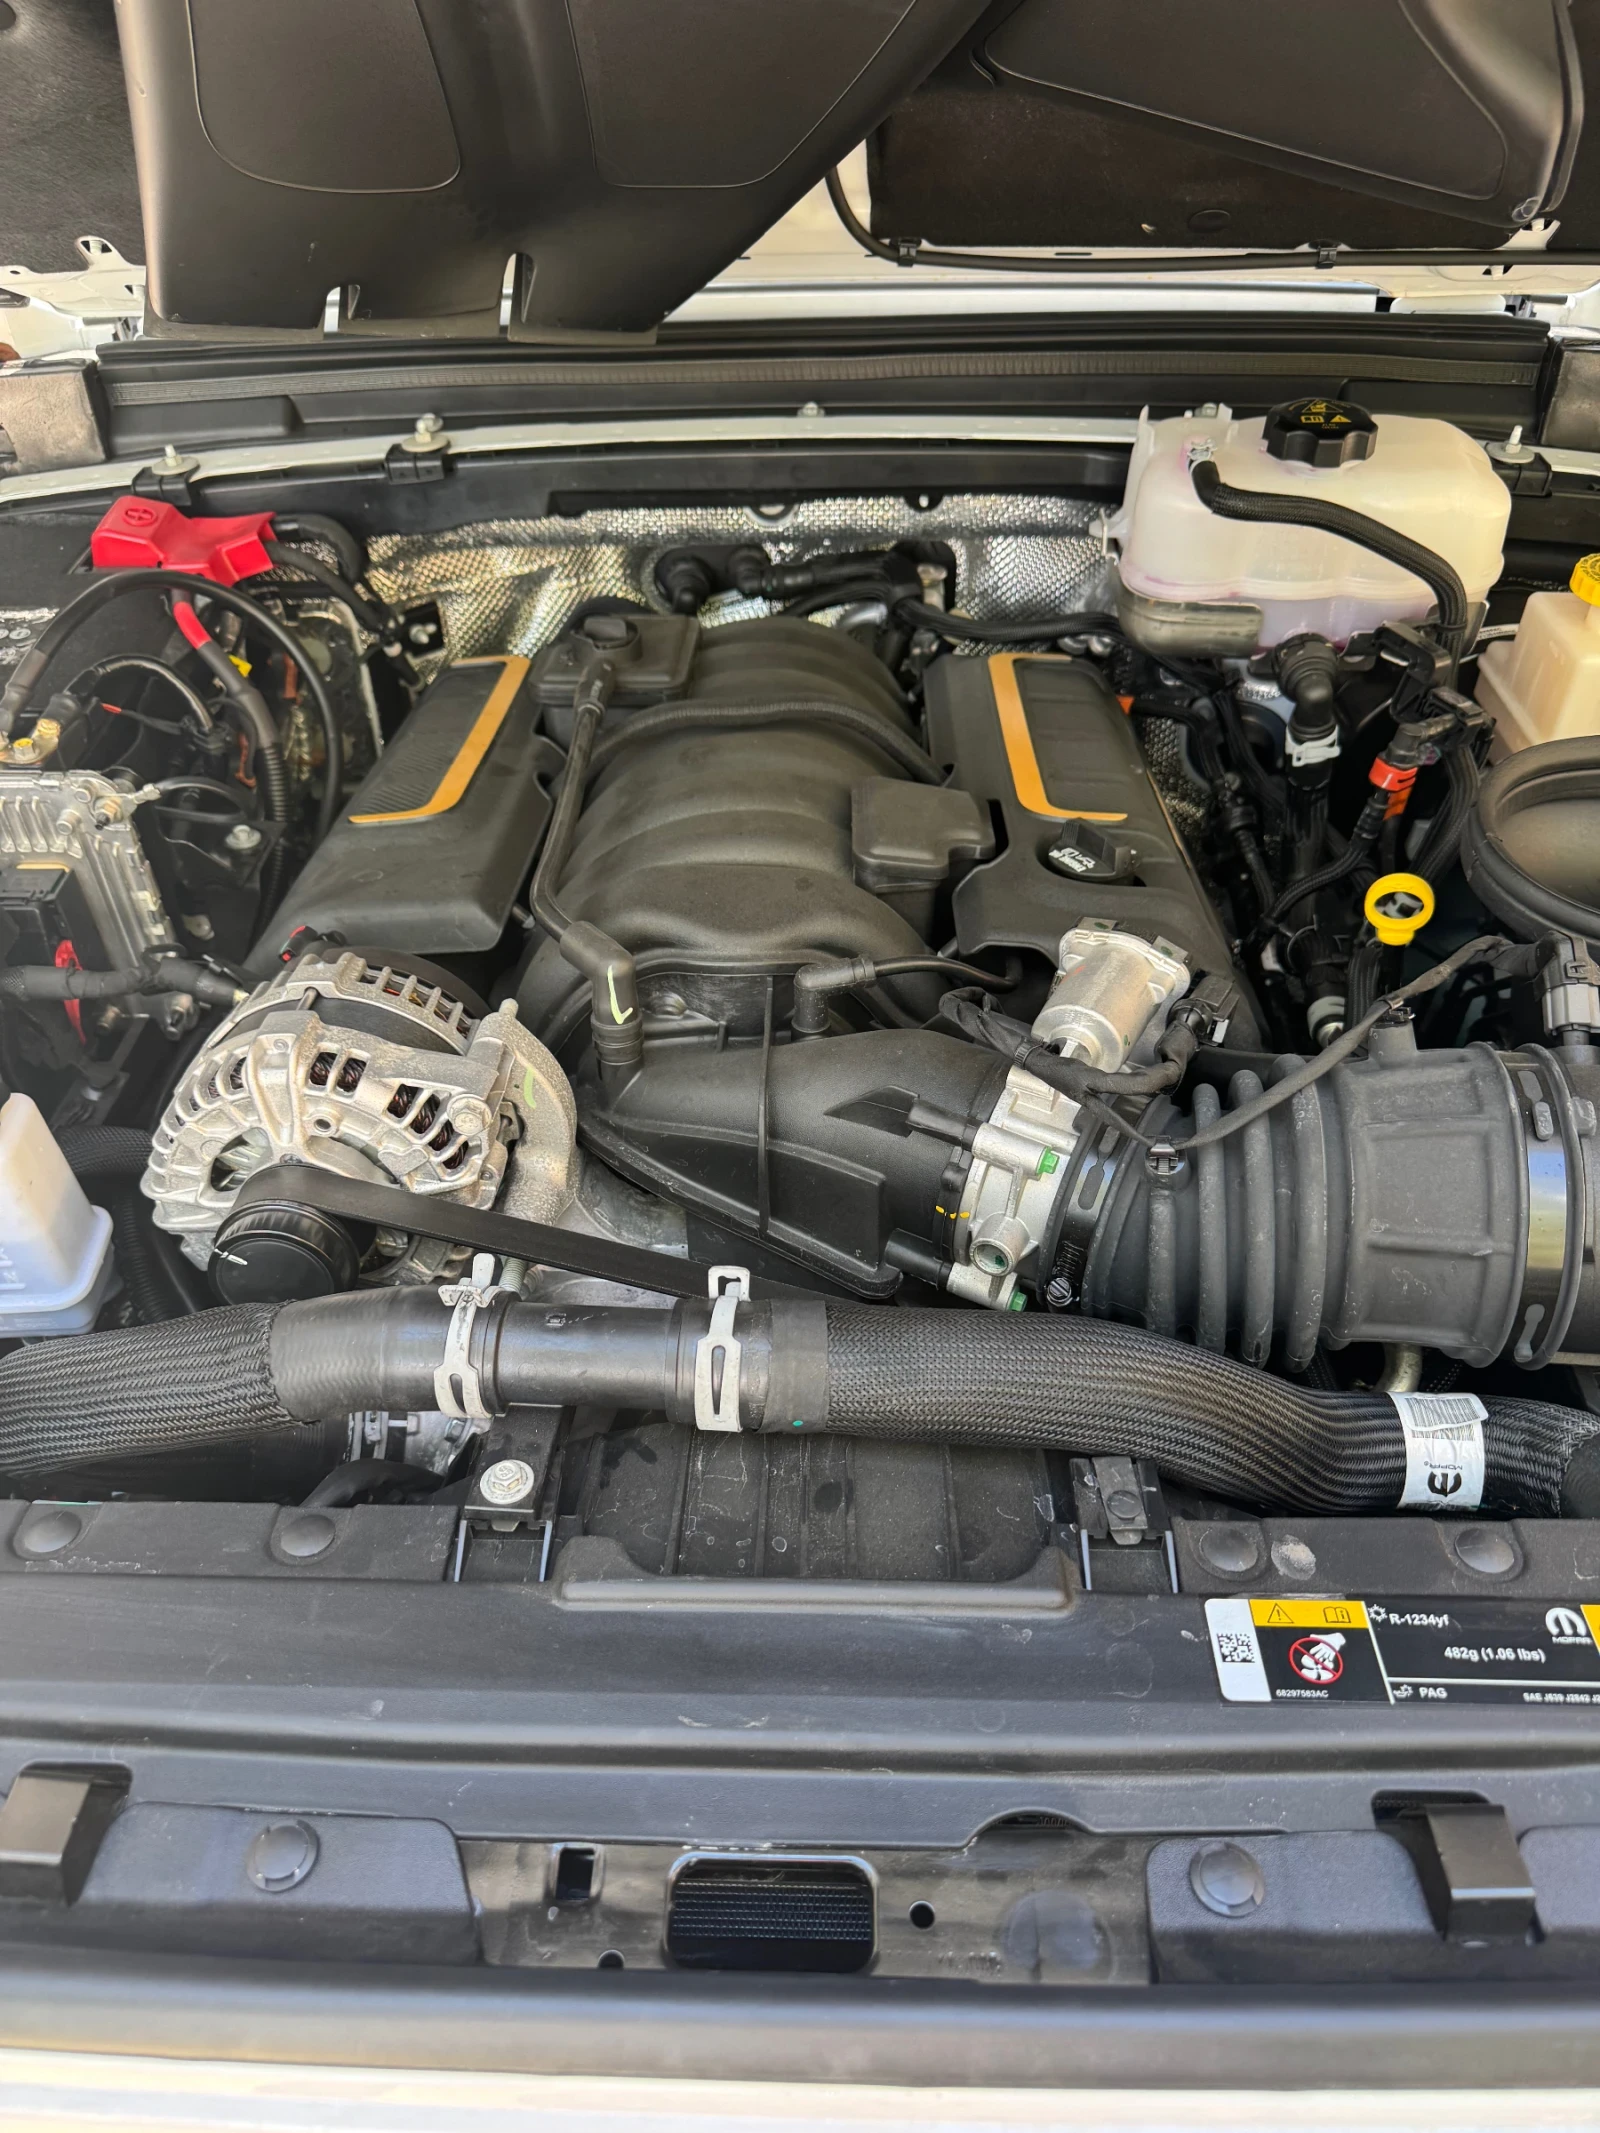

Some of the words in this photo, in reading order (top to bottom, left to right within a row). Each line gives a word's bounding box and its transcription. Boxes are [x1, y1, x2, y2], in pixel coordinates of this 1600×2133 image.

[1389, 1613, 1449, 1629] R-1234yf
[1444, 1646, 1479, 1662] 482g
[1481, 1647, 1515, 1662] (1.06
[1517, 1648, 1547, 1664] lbs)
[1419, 1687, 1448, 1699] PAG
